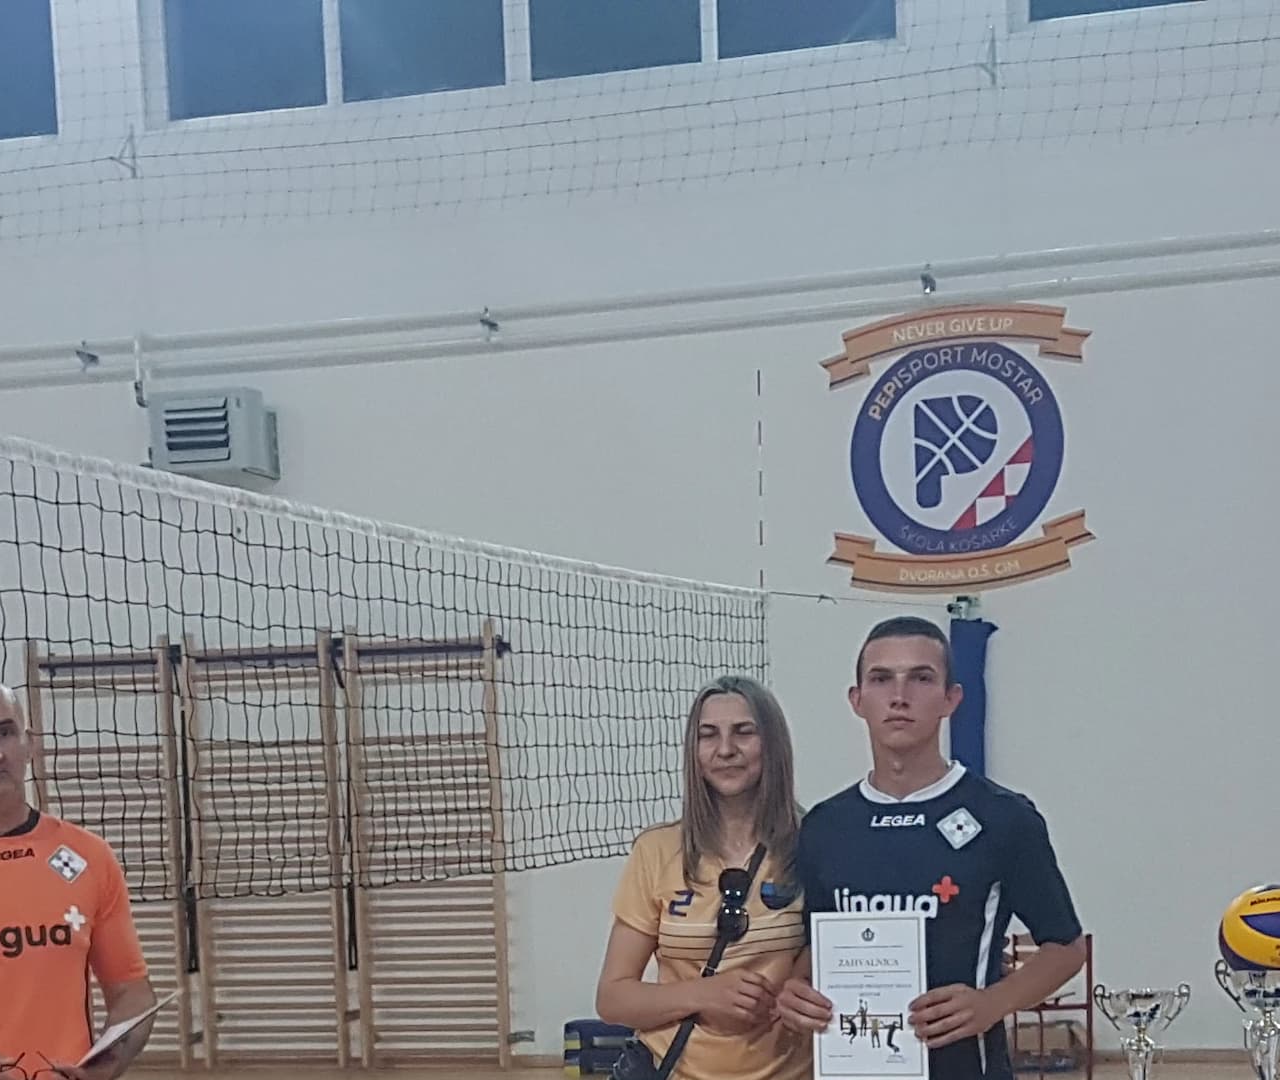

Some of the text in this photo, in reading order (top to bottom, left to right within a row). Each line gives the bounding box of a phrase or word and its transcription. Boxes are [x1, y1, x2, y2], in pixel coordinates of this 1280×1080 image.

[892, 317, 1014, 343] NEVER GIVE UP
[970, 348, 1044, 405] MOSTAR
[870, 814, 926, 828] LEGEA
[668, 888, 695, 917] 2
